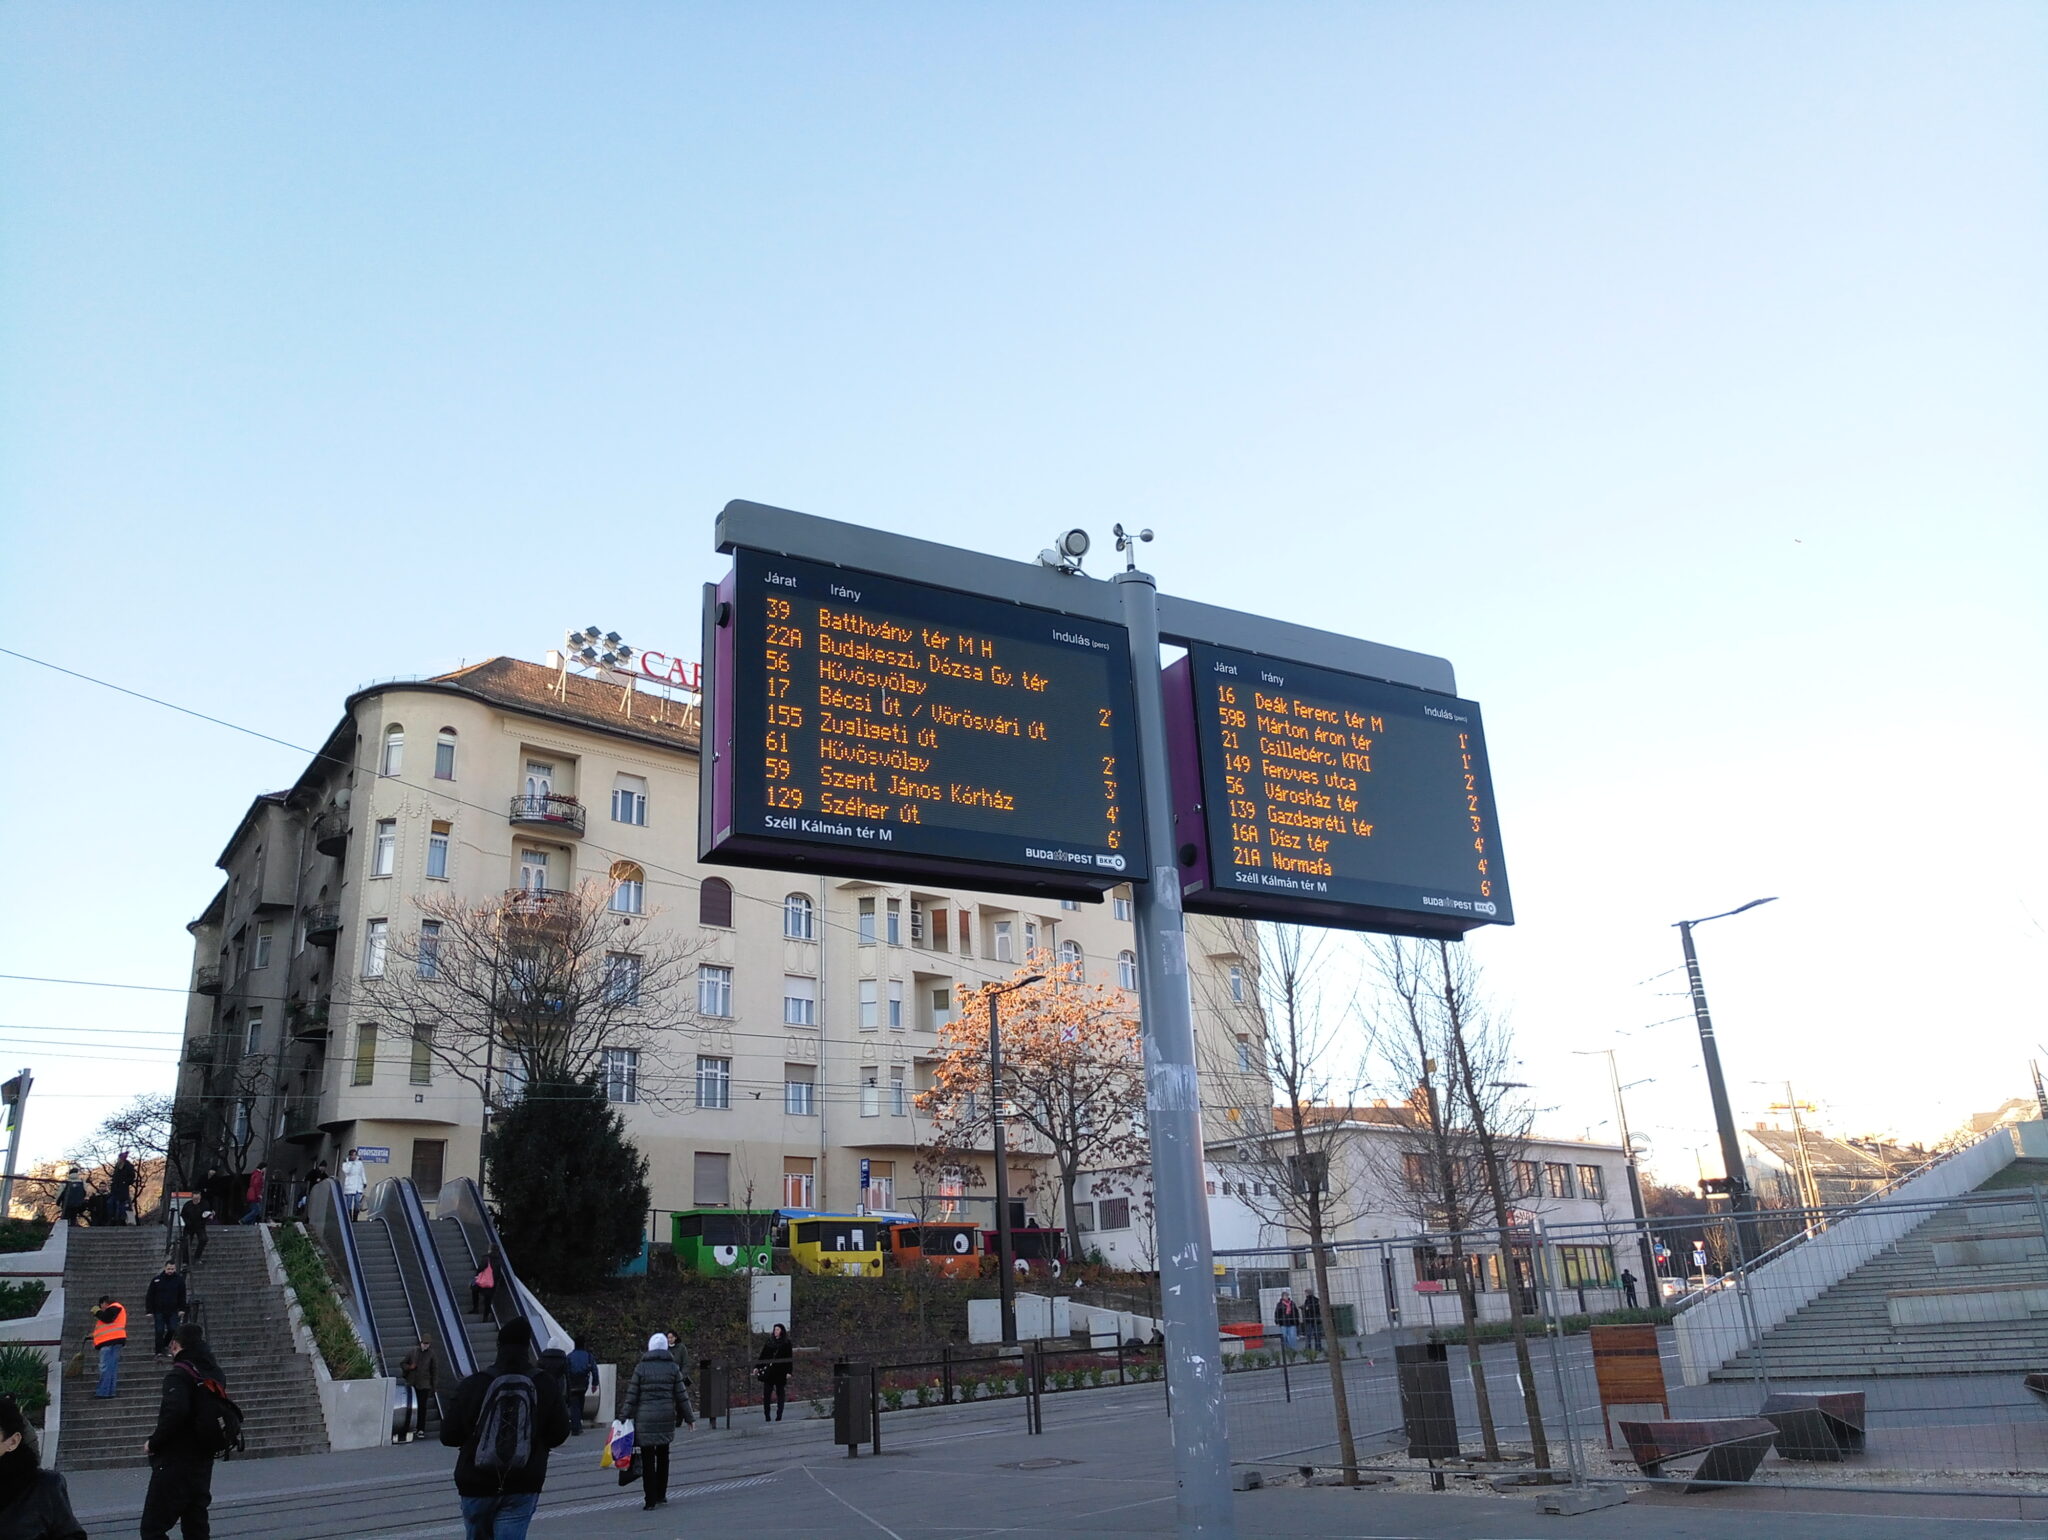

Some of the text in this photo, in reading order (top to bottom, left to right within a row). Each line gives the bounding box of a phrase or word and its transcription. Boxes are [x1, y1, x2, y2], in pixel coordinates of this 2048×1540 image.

[764, 571, 798, 588] Járat
[830, 584, 862, 602] Irány
[1052, 629, 1091, 647] Indulás
[766, 597, 791, 620] 39
[921, 628, 950, 650] tér
[958, 634, 974, 656] M
[981, 639, 993, 659] H
[766, 624, 1049, 692] 22A Budakeszi, Dózsa Gy. tér
[766, 650, 791, 672] 56
[819, 659, 927, 695] Hűvösvölgy
[768, 676, 1048, 741] 17 Bécsi út / Vörösvári út
[1214, 661, 1238, 676] Járat
[1261, 671, 1285, 687] Irány
[1424, 705, 1454, 720] Indulás
[1218, 685, 1236, 704] 16
[1255, 692, 1289, 715] Deák
[1293, 700, 1340, 725] Ferenc
[1344, 710, 1366, 730] tér
[1370, 715, 1384, 733] M
[767, 703, 803, 728] 155
[820, 711, 909, 744] Zugligeti
[918, 727, 939, 749] út
[1218, 707, 1246, 728] 59B
[1257, 714, 1309, 740] Márton
[1314, 725, 1347, 748] Áron
[1351, 731, 1372, 752] tér
[765, 730, 789, 753] 61
[820, 738, 931, 773] Hűvösvölgy
[1221, 730, 1239, 750] 21
[1259, 737, 1338, 767] Csillebérc,
[1341, 751, 1372, 773] KFKI
[1225, 753, 1251, 774] 149
[1262, 759, 1320, 785] Fenyves
[1324, 771, 1358, 792] utca
[765, 757, 791, 780] 59
[820, 765, 878, 792] Szent
[887, 774, 942, 801] János
[950, 783, 1015, 811] Kórház
[767, 786, 803, 809] 129
[821, 792, 890, 820] Széher
[899, 803, 921, 825] út
[1225, 775, 1245, 795] 56
[1264, 781, 1332, 809] Városház
[1337, 793, 1359, 813] tér
[765, 815, 893, 841] Széll Kálmán tér M
[1229, 799, 1256, 820] 139
[1267, 804, 1347, 834] Gazdagréti
[1351, 818, 1374, 837] tér
[1231, 823, 1259, 844] 16A
[1269, 828, 1301, 849] Dísz
[1307, 833, 1330, 854] tér
[1232, 846, 1262, 867] 21A
[1272, 851, 1333, 877] Normafa
[1235, 871, 1328, 893] Széll Kálmán tér M
